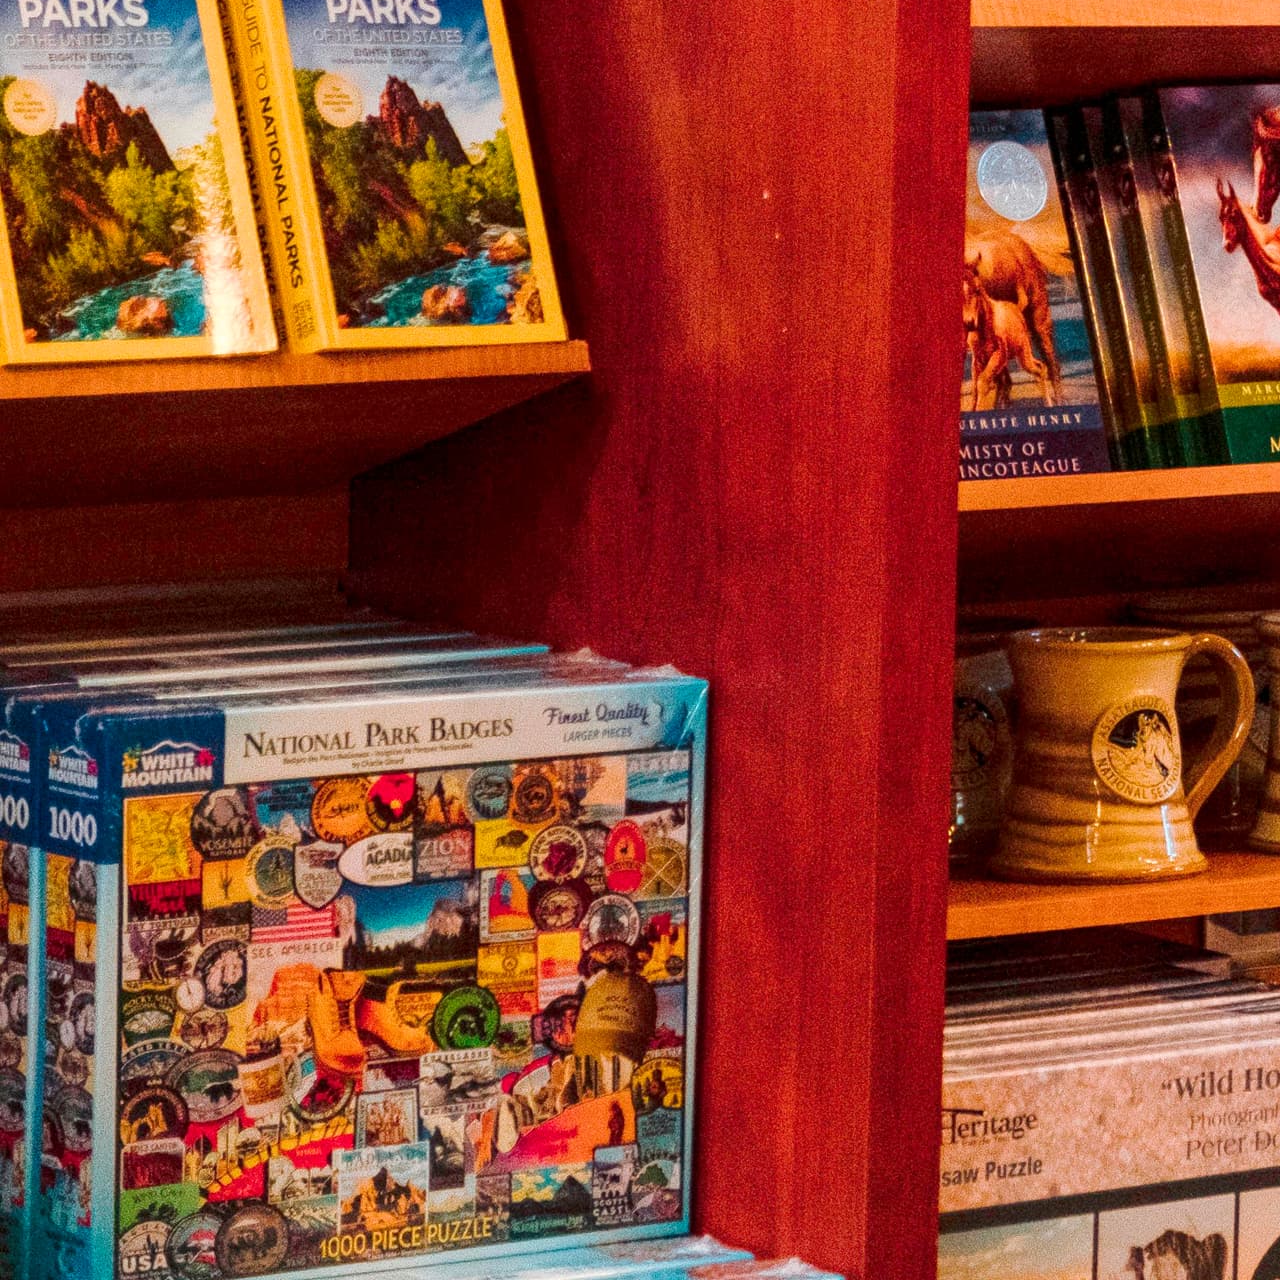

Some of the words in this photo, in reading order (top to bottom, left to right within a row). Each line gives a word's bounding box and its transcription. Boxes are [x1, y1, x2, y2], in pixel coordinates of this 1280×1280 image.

[254, 65, 268, 91] TO
[259, 95, 290, 206] NATIONAL
[283, 216, 303, 290] PARKS
[959, 418, 1019, 430] UERITE
[1028, 413, 1081, 426] HENRY
[960, 444, 1012, 459] MISTY
[1022, 442, 1046, 456] OF
[960, 458, 1080, 479] INCOTEAGUE
[243, 732, 356, 757] NATIONAL
[366, 722, 419, 748] PARK
[430, 717, 513, 742] BADGES
[563, 729, 598, 741] LARGER
[601, 727, 632, 739] PIECES
[58, 757, 87, 774] WHITE
[141, 751, 195, 769] WHITE
[122, 767, 213, 788] MOUNTAIN
[49, 807, 97, 847] 1000
[1186, 1134, 1246, 1160] Peter
[320, 1234, 366, 1258] 1000
[372, 1229, 421, 1250] PIECE
[428, 1218, 492, 1243] PUZZLE
[123, 1256, 168, 1271] USA
